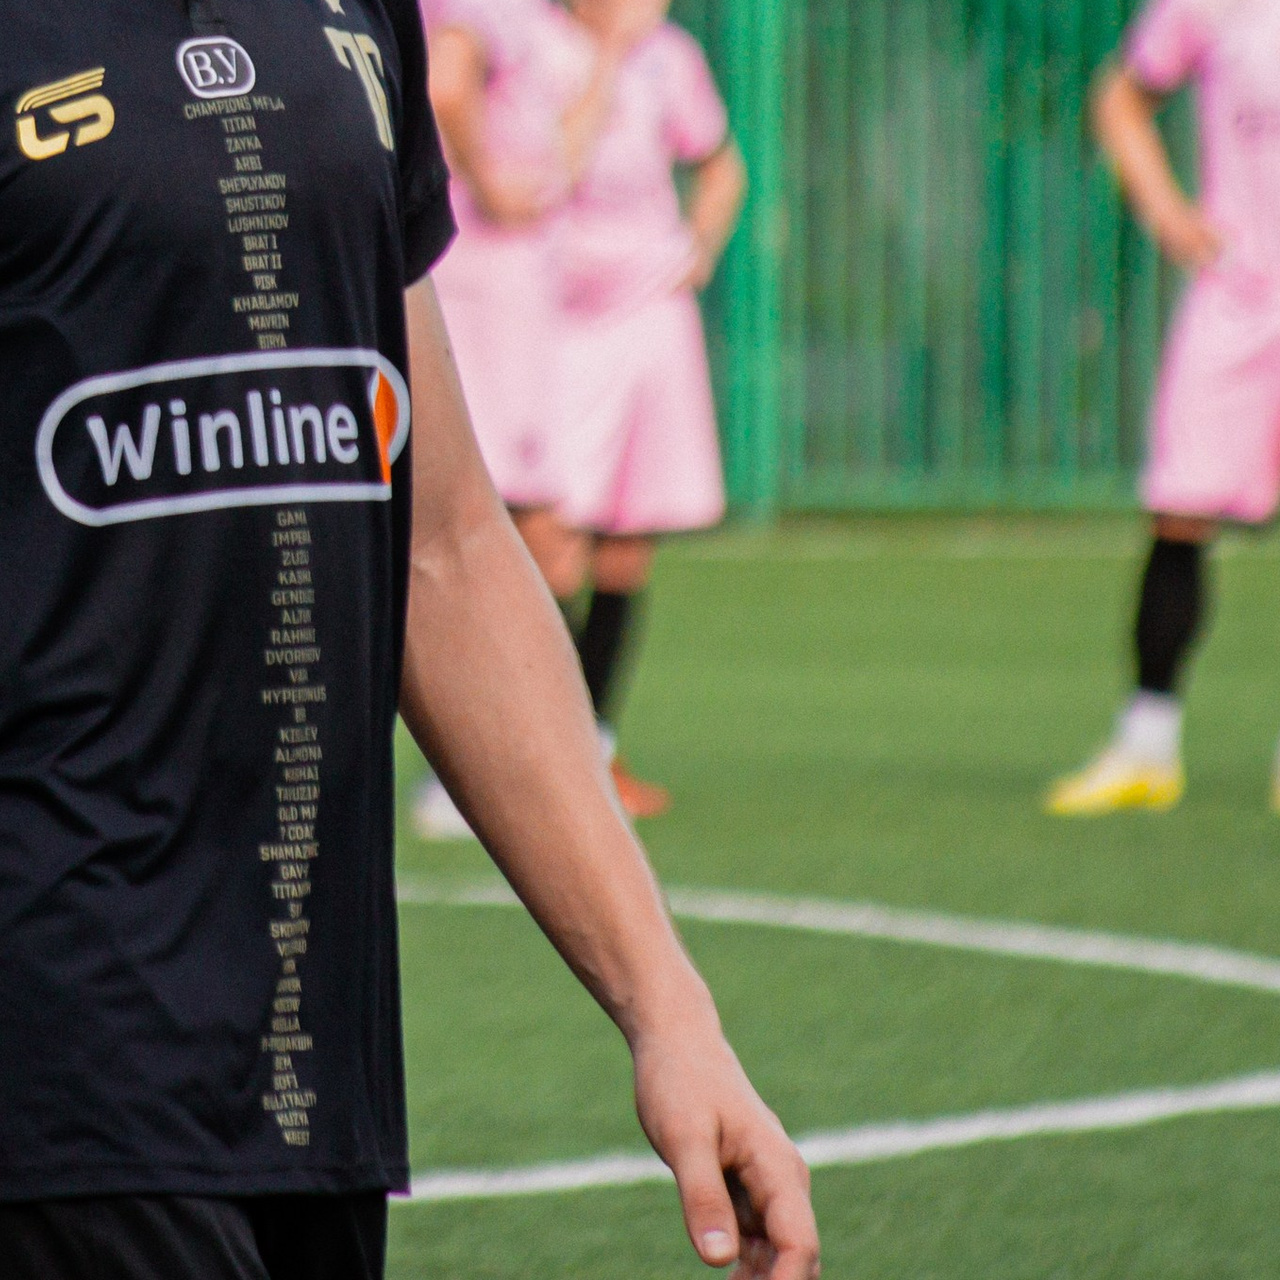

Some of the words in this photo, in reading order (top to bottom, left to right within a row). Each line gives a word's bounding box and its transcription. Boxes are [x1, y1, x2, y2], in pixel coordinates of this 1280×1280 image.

[184, 97, 252, 120] CHAMPIONS
[222, 116, 257, 134] TITAN
[225, 136, 263, 154] ZAYKA
[234, 155, 263, 172] ARBI
[218, 174, 287, 195] SHEPLYAKOV
[225, 195, 287, 214] SHUSTIKOV
[227, 214, 289, 233] LUSHNIKOV
[243, 235, 269, 252] BRAT
[243, 254, 270, 272] BRAT
[233, 293, 300, 313] KHARLAMOV
[86, 387, 360, 487] Winline
